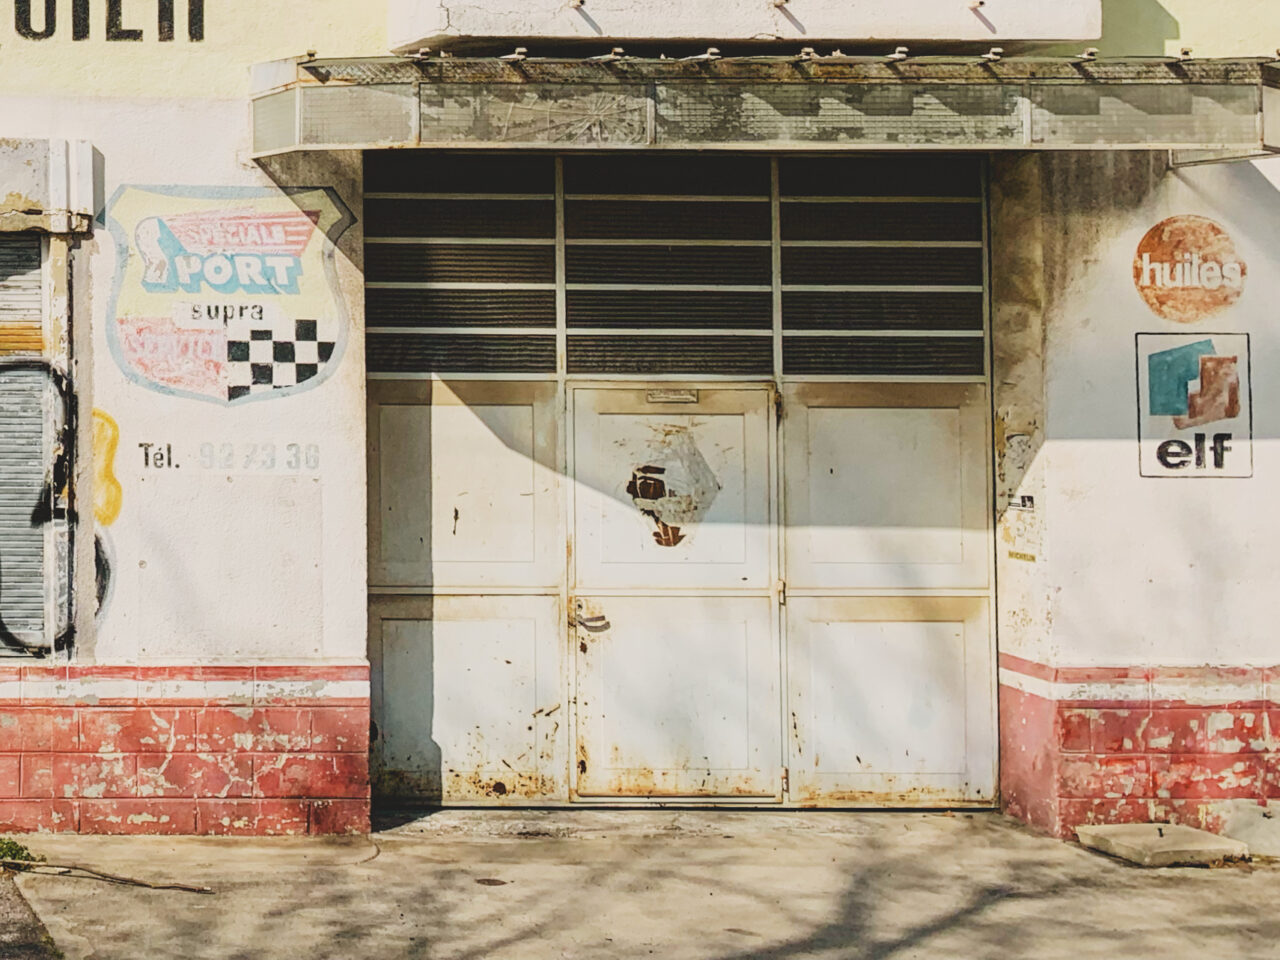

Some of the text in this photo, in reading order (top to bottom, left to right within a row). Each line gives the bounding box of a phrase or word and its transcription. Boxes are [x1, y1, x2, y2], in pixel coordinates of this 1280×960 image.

[135, 216, 302, 293] SPORT
[1140, 252, 1242, 289] huiles
[191, 301, 264, 328] supra
[138, 442, 180, 469] Tél.
[1156, 433, 1232, 469] elf
